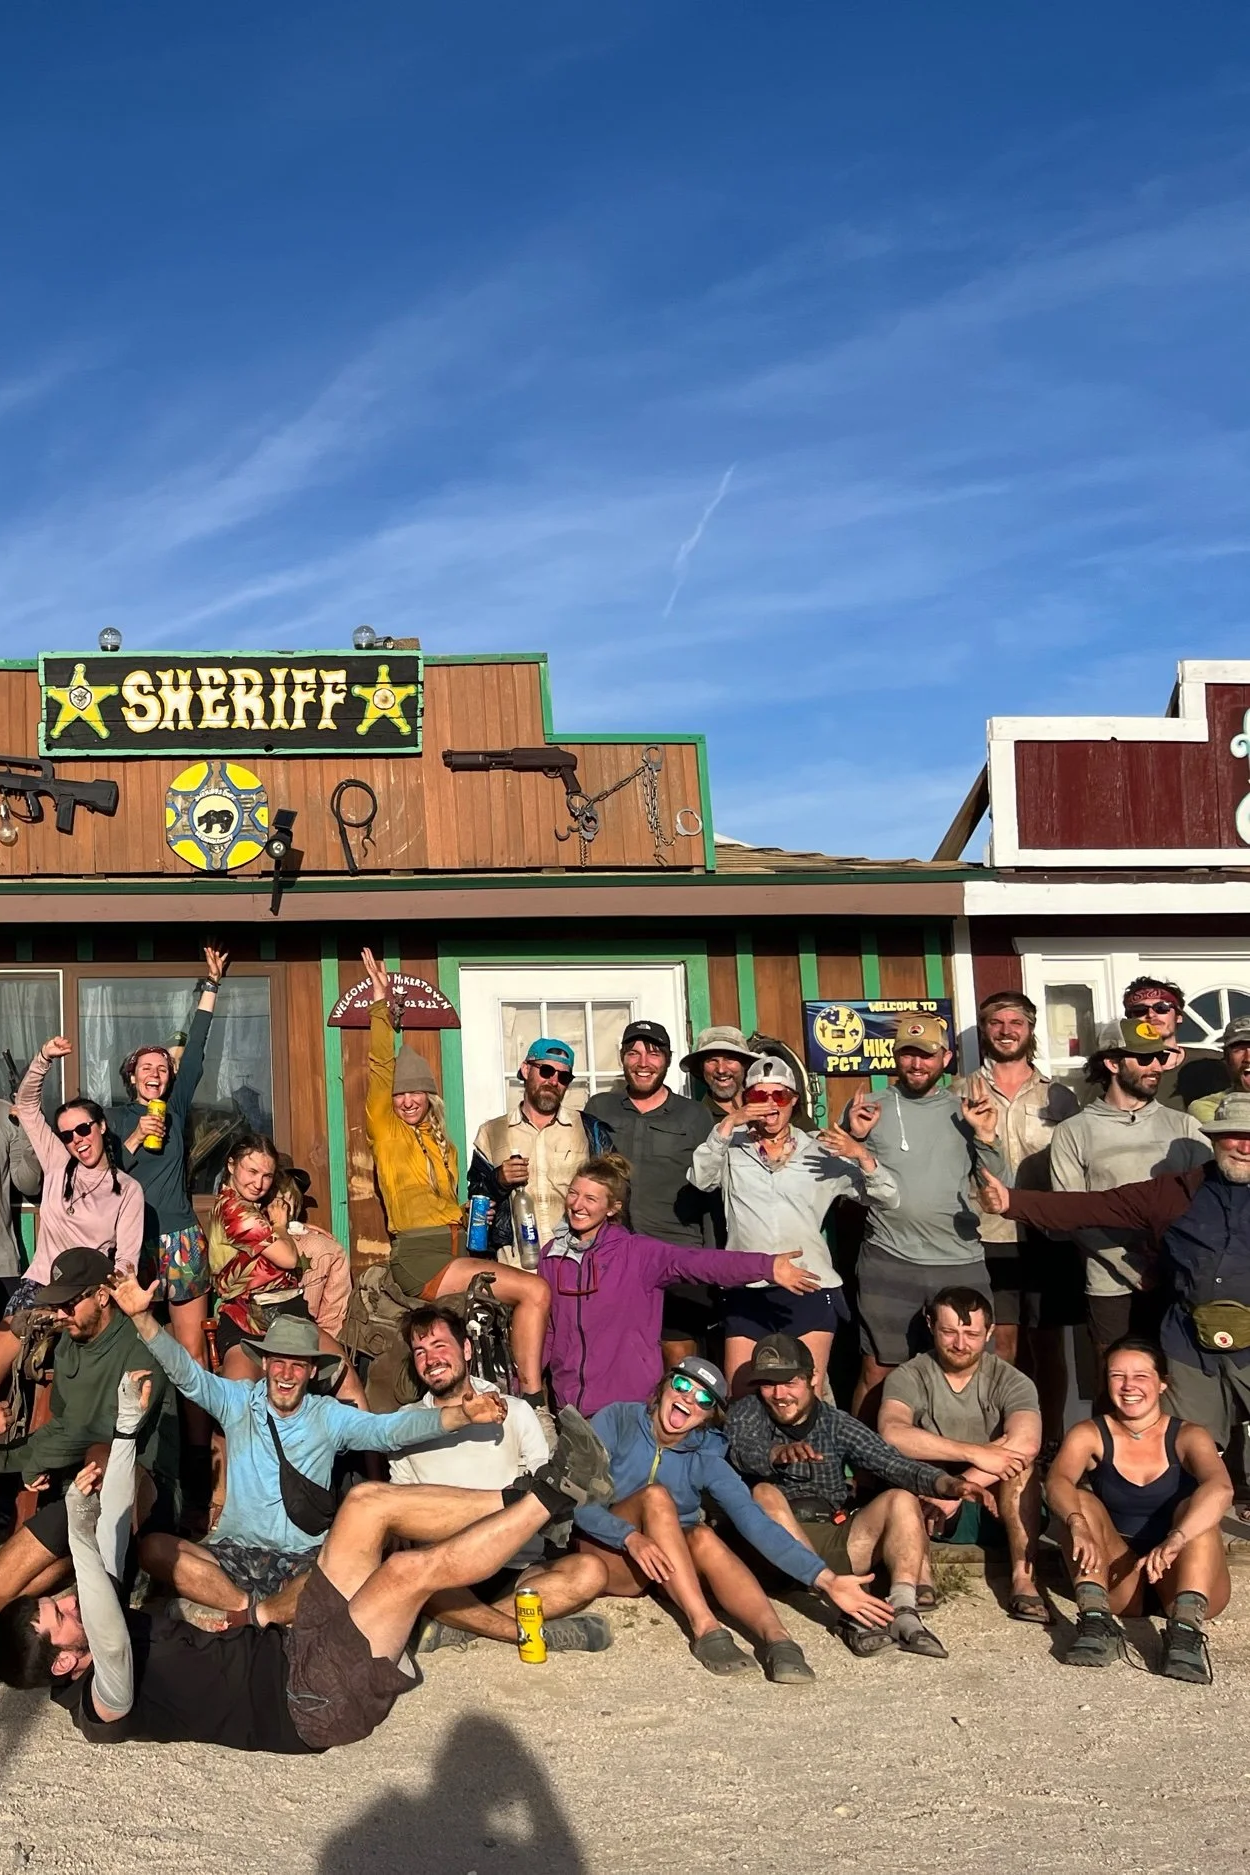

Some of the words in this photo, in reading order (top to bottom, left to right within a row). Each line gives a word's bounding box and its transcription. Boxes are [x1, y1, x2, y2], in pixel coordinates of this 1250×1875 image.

[121, 667, 348, 733] SHERIFF
[333, 978, 373, 1019] WELCOME
[354, 1000, 368, 1008] 20
[425, 1000, 439, 1009] 22
[868, 1002, 918, 1012] WELCOME
[920, 1002, 937, 1011] TO
[827, 1057, 861, 1072] PCT
